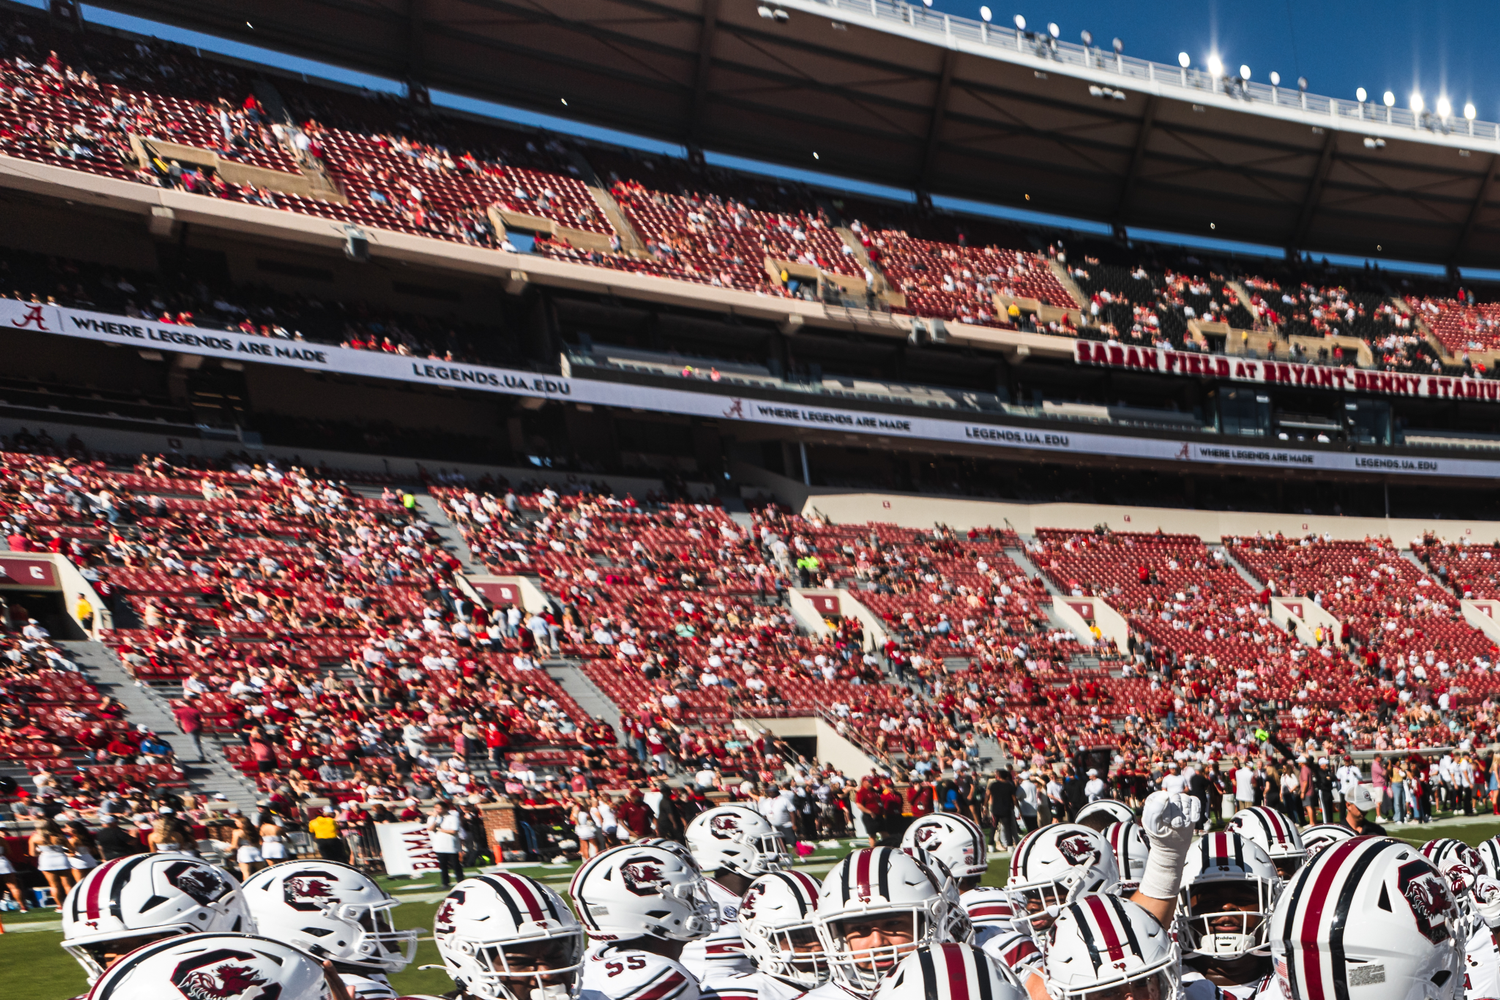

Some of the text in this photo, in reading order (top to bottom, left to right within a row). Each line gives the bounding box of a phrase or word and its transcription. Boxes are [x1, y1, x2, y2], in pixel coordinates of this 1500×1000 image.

[71, 316, 327, 364] WHERE LEGENDS ARE MADE
[412, 363, 571, 396] LEGENDS.UA.EDU
[1077, 341, 1157, 369] SABAN
[1164, 353, 1230, 377] FIELD
[1235, 364, 1258, 378] AT
[1263, 361, 1421, 395] BRYANT-DENNY
[758, 406, 911, 432] WHERE LEGENDS ARE MADE
[964, 426, 1070, 447] LEGENDS.UA.EDU
[1199, 447, 1314, 464] WHERE LEGENDS ARE MADE
[1355, 457, 1438, 471] LEGENDS.UA.EDU
[605, 955, 647, 978] 55
